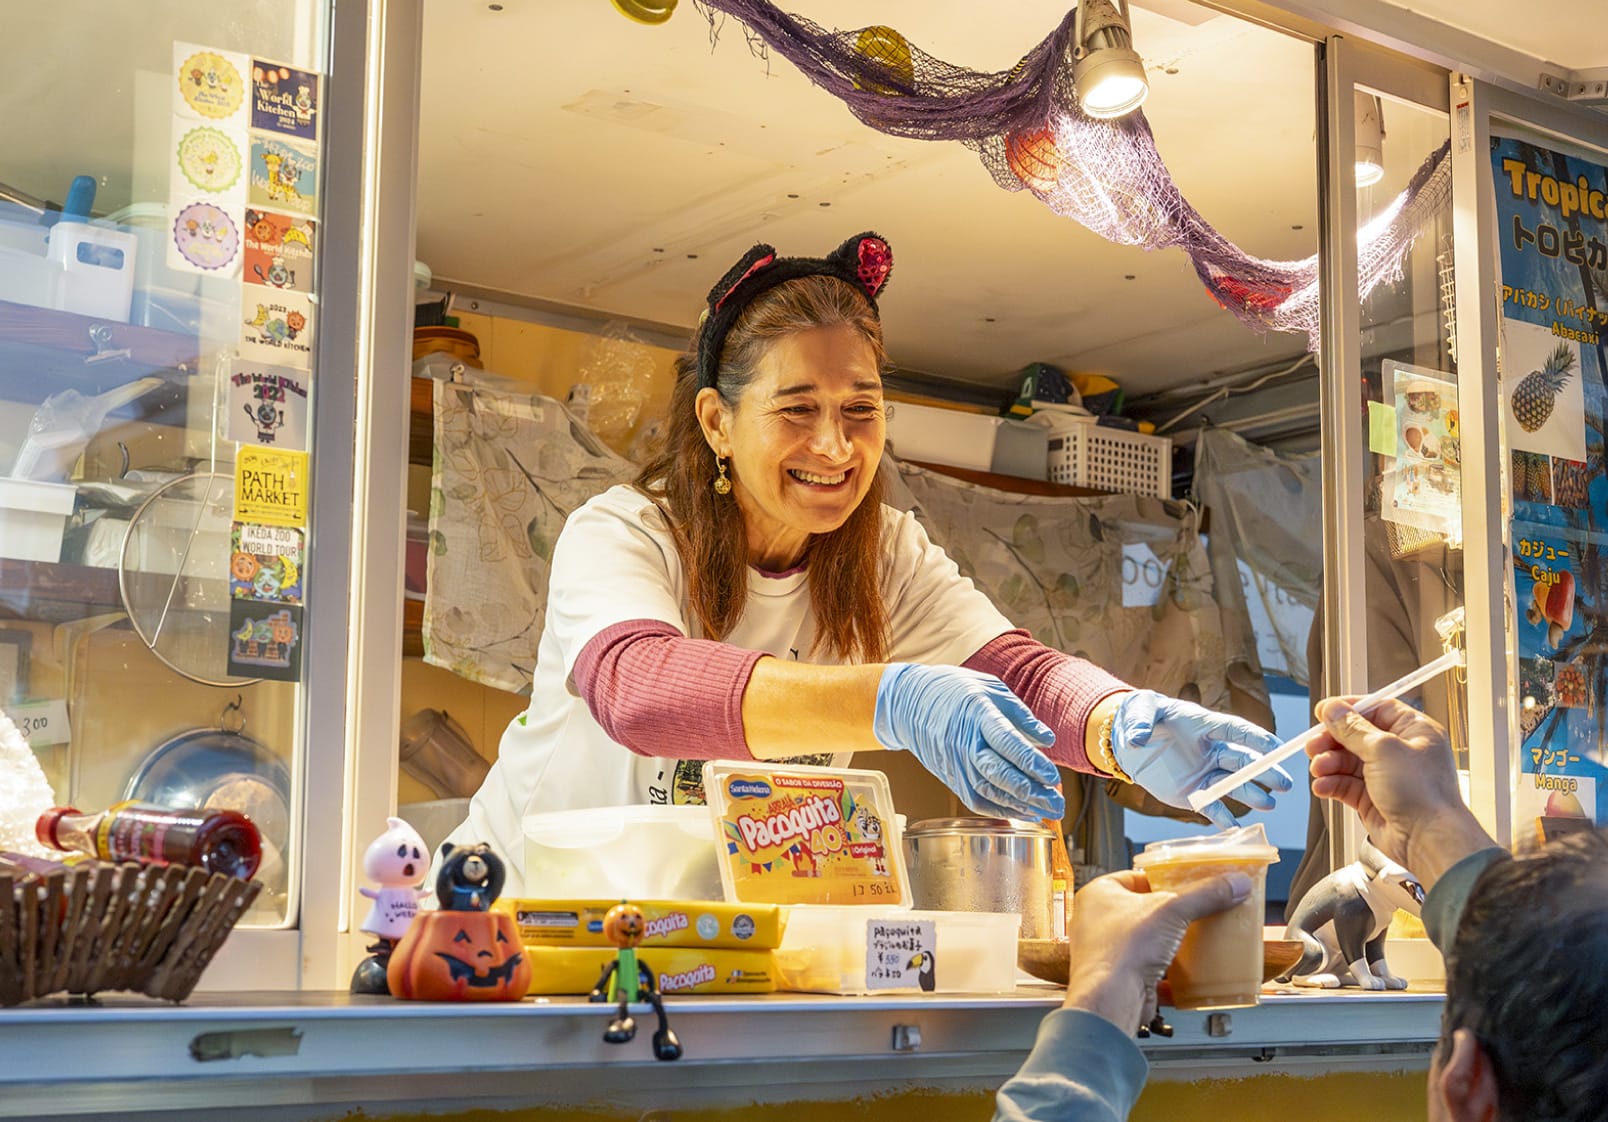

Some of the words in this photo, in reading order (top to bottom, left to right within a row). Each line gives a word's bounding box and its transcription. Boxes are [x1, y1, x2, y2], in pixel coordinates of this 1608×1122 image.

[259, 87, 293, 107] World
[257, 99, 296, 119] Kitchen
[1513, 214, 1608, 272] トロピカ
[1551, 320, 1600, 346] Abacaxi
[245, 335, 257, 345] THE
[258, 338, 282, 349] WORLD
[284, 341, 311, 353] KITCHEN
[231, 372, 252, 388] The
[253, 383, 286, 404] 2022
[242, 469, 285, 491] PATH
[241, 487, 300, 507] MARKET
[247, 527, 273, 541] IKEDA
[274, 530, 291, 543] ZOO
[242, 541, 273, 555] WORLD
[275, 544, 297, 558] TOUR
[1519, 538, 1570, 560] カジュー
[1531, 565, 1561, 586] Caju
[1531, 748, 1580, 767] マンゴー
[1535, 773, 1578, 796] Manga
[739, 796, 840, 850] Paçoquita
[811, 825, 843, 855] 40
[854, 844, 877, 857] Original
